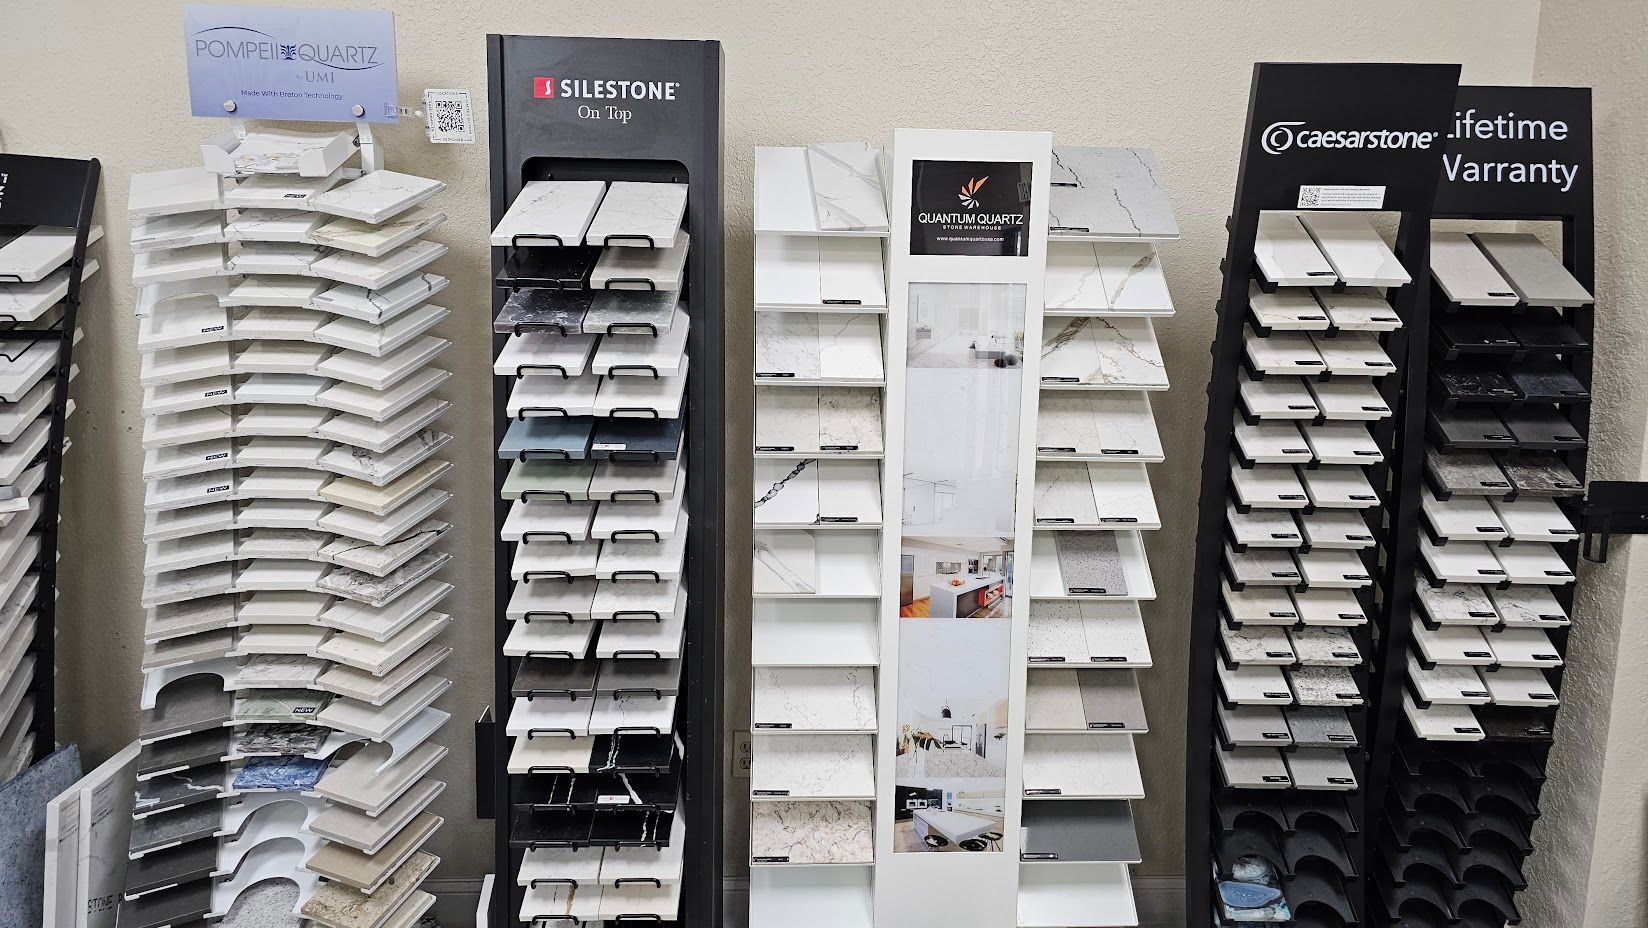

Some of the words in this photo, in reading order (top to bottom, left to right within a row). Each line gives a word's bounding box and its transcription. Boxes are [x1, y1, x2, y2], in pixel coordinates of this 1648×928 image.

[195, 40, 279, 60] POMPEII
[298, 44, 379, 64] QUARTZ
[305, 71, 335, 83] UMI
[261, 90, 279, 98] With
[304, 92, 343, 101] Technology
[560, 79, 676, 100] SILESTONE
[578, 105, 600, 119] On
[605, 106, 632, 124] Top
[1296, 129, 1433, 149] caesarstone
[918, 212, 975, 224] QUANTUM
[977, 214, 1024, 225] QUARTZ
